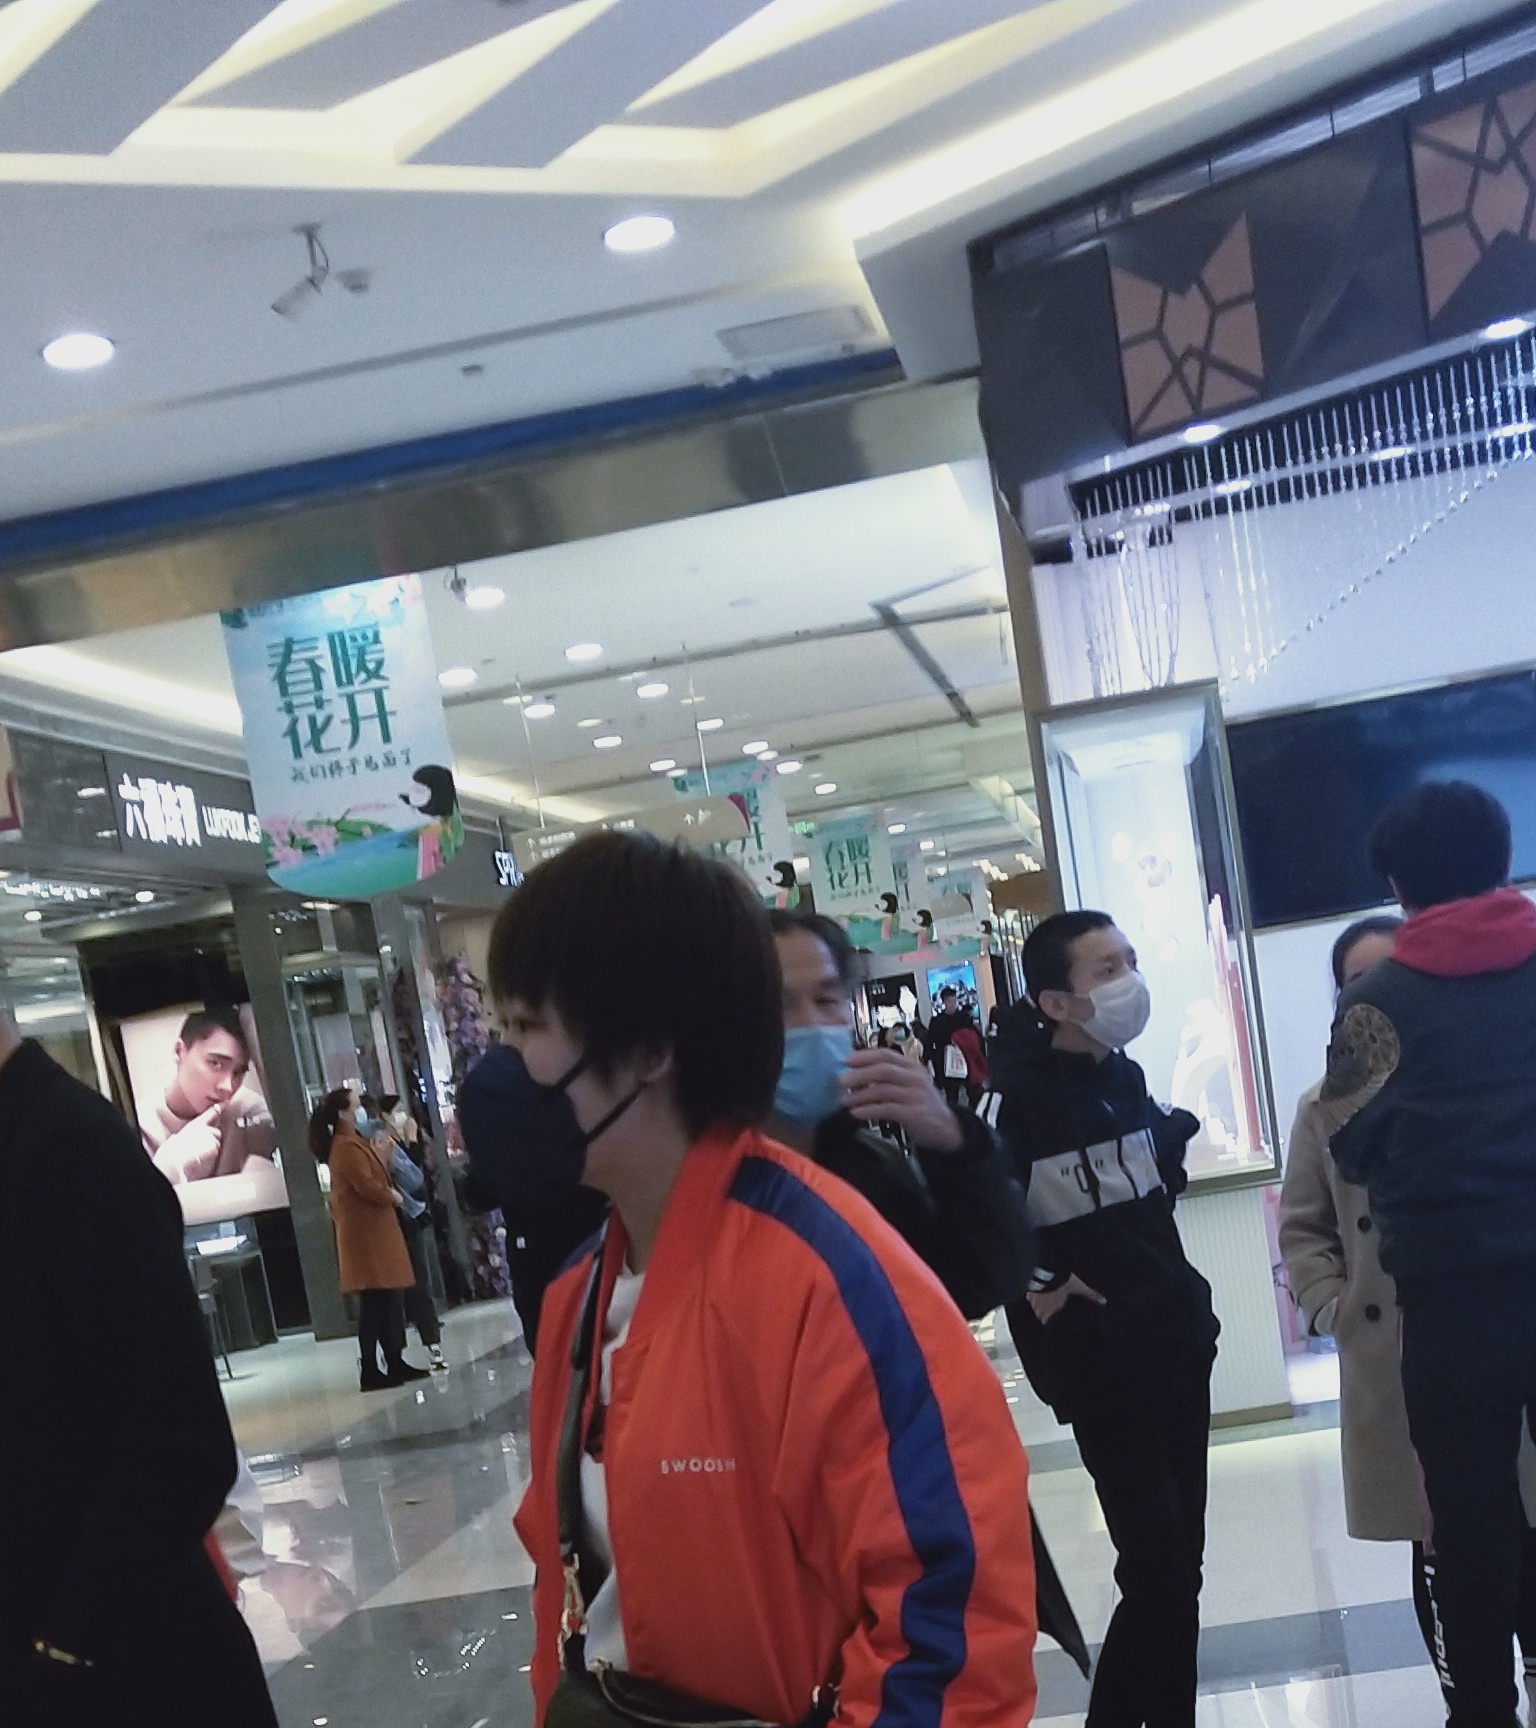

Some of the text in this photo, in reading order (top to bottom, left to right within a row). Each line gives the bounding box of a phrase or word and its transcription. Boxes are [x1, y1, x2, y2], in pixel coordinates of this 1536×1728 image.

[267, 620, 390, 698] 春暖
[277, 684, 397, 760] 花开
[660, 1457, 736, 1475] SWOOSH
